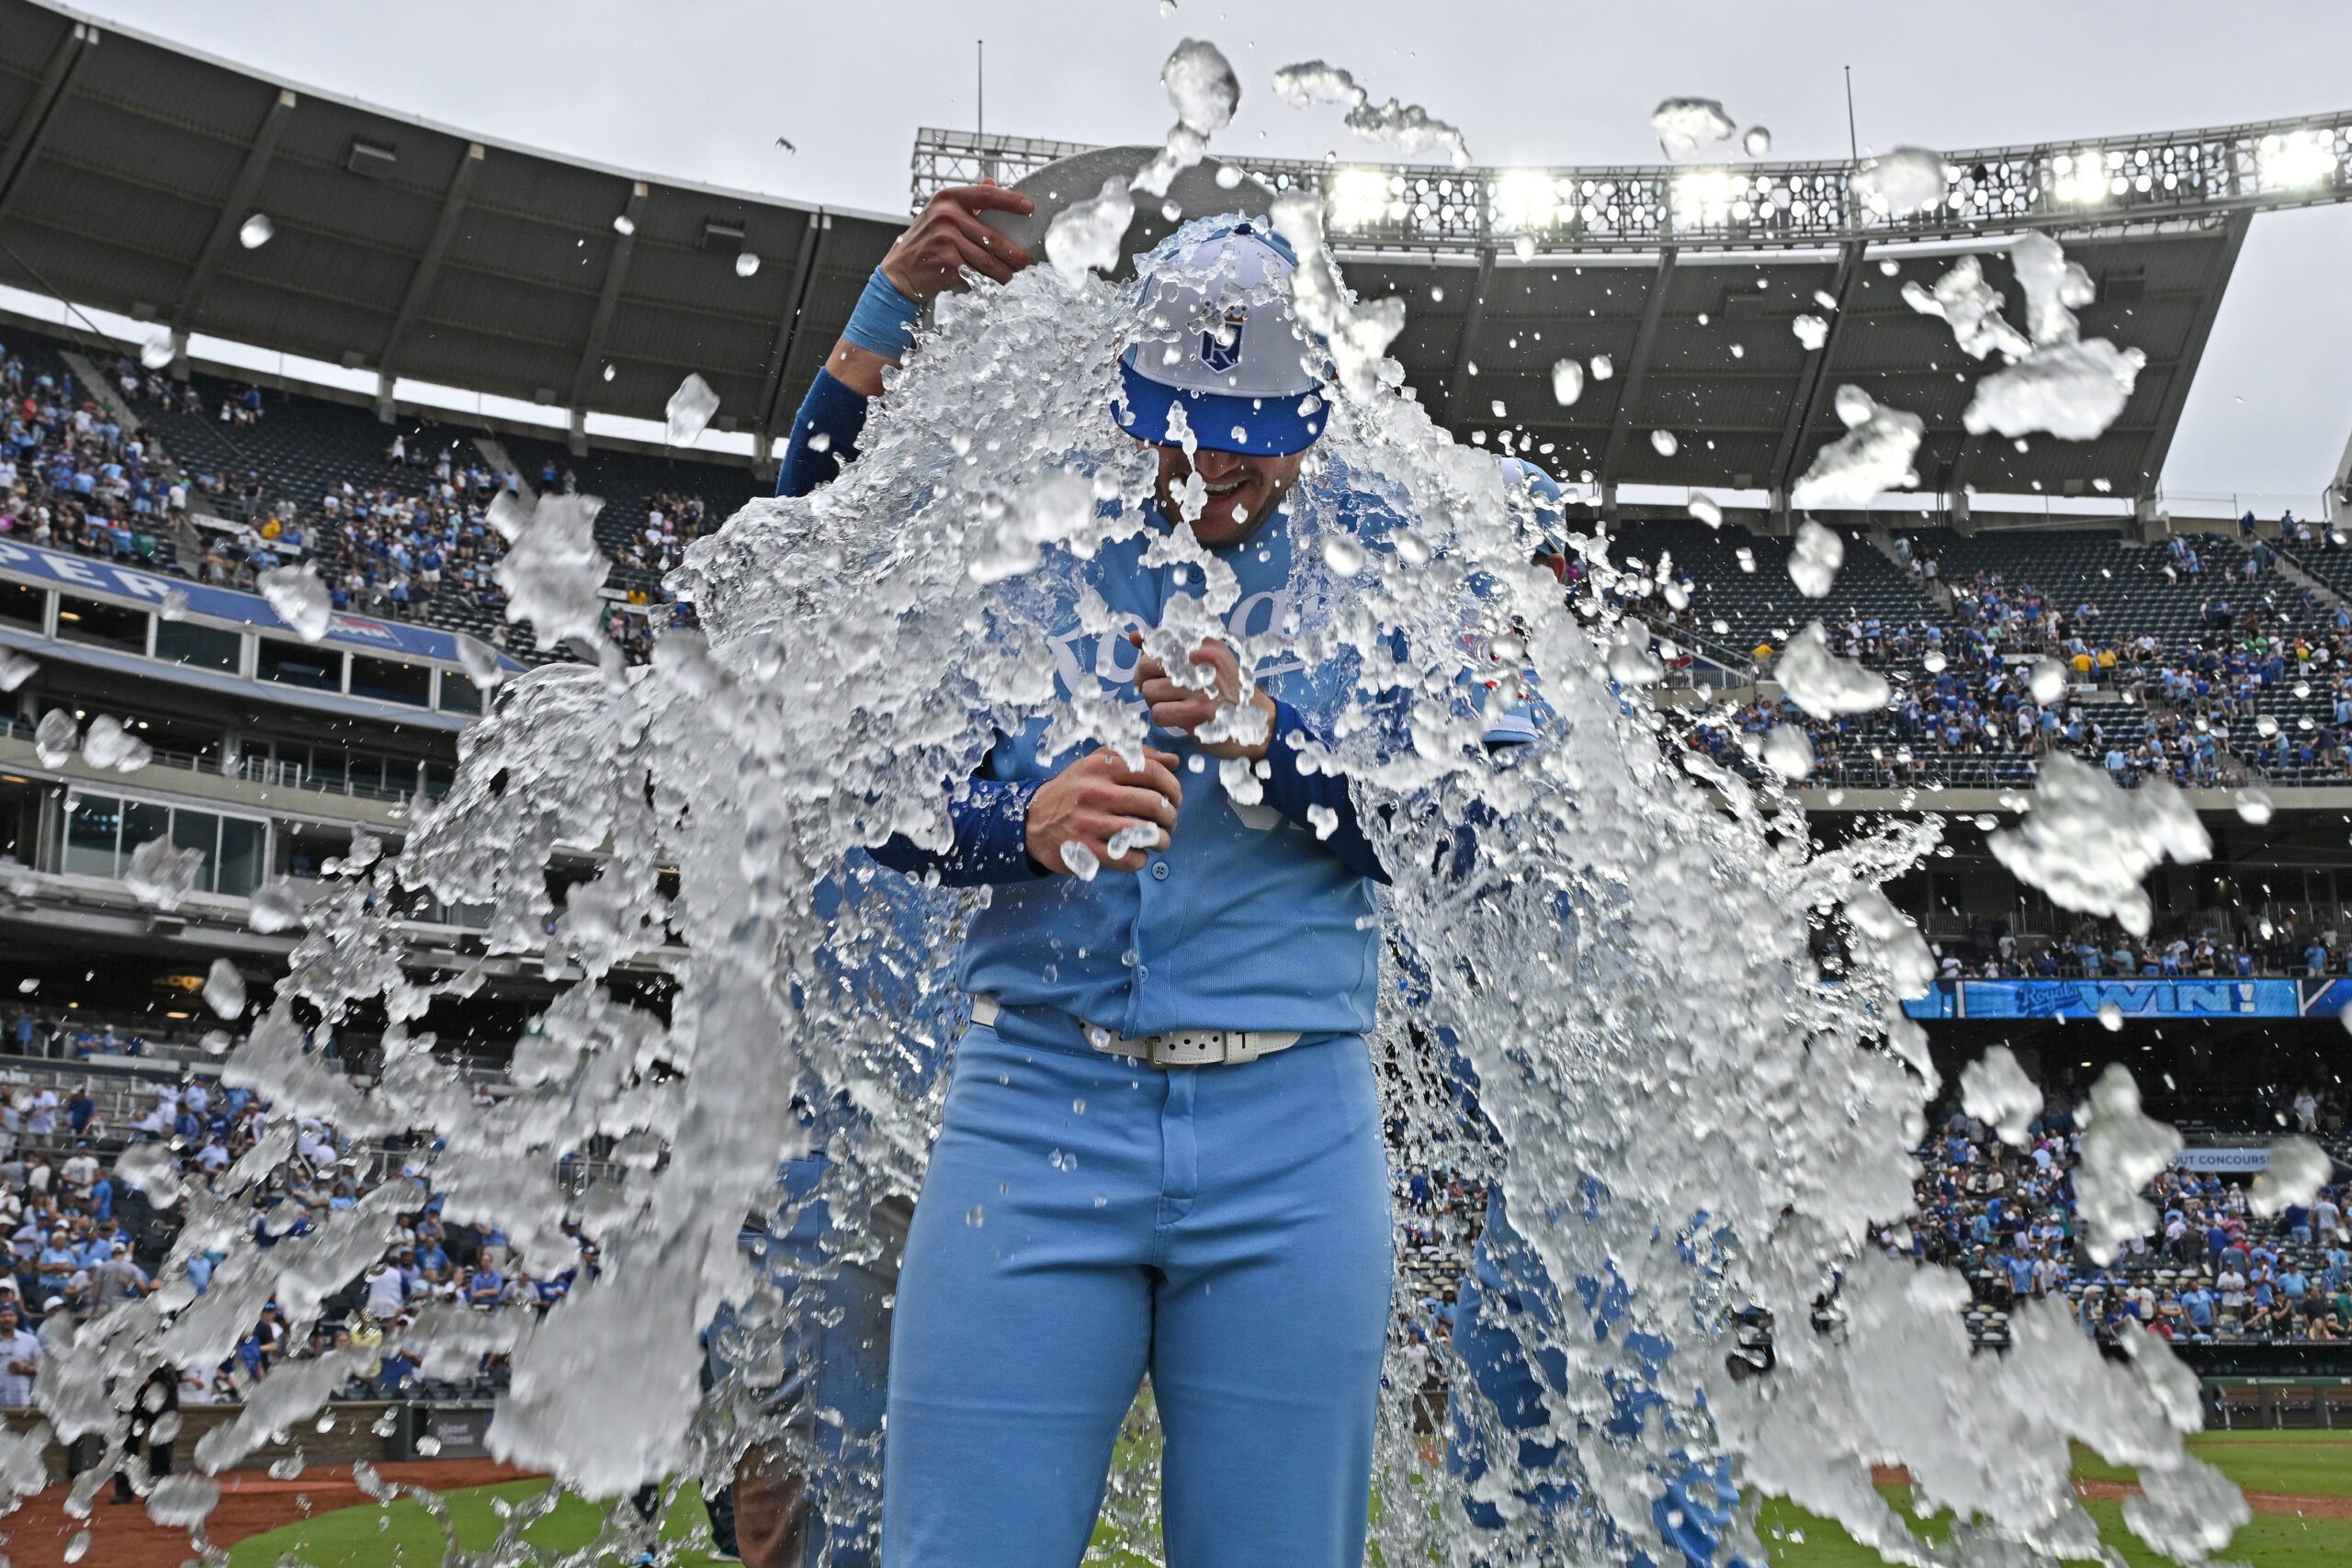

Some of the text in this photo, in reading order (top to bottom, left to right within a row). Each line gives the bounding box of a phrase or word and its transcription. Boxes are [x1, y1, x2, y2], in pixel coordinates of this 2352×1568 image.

[2018, 983, 2256, 1012] Royals WIN!
[2199, 1155, 2270, 1165] CONCOURS
